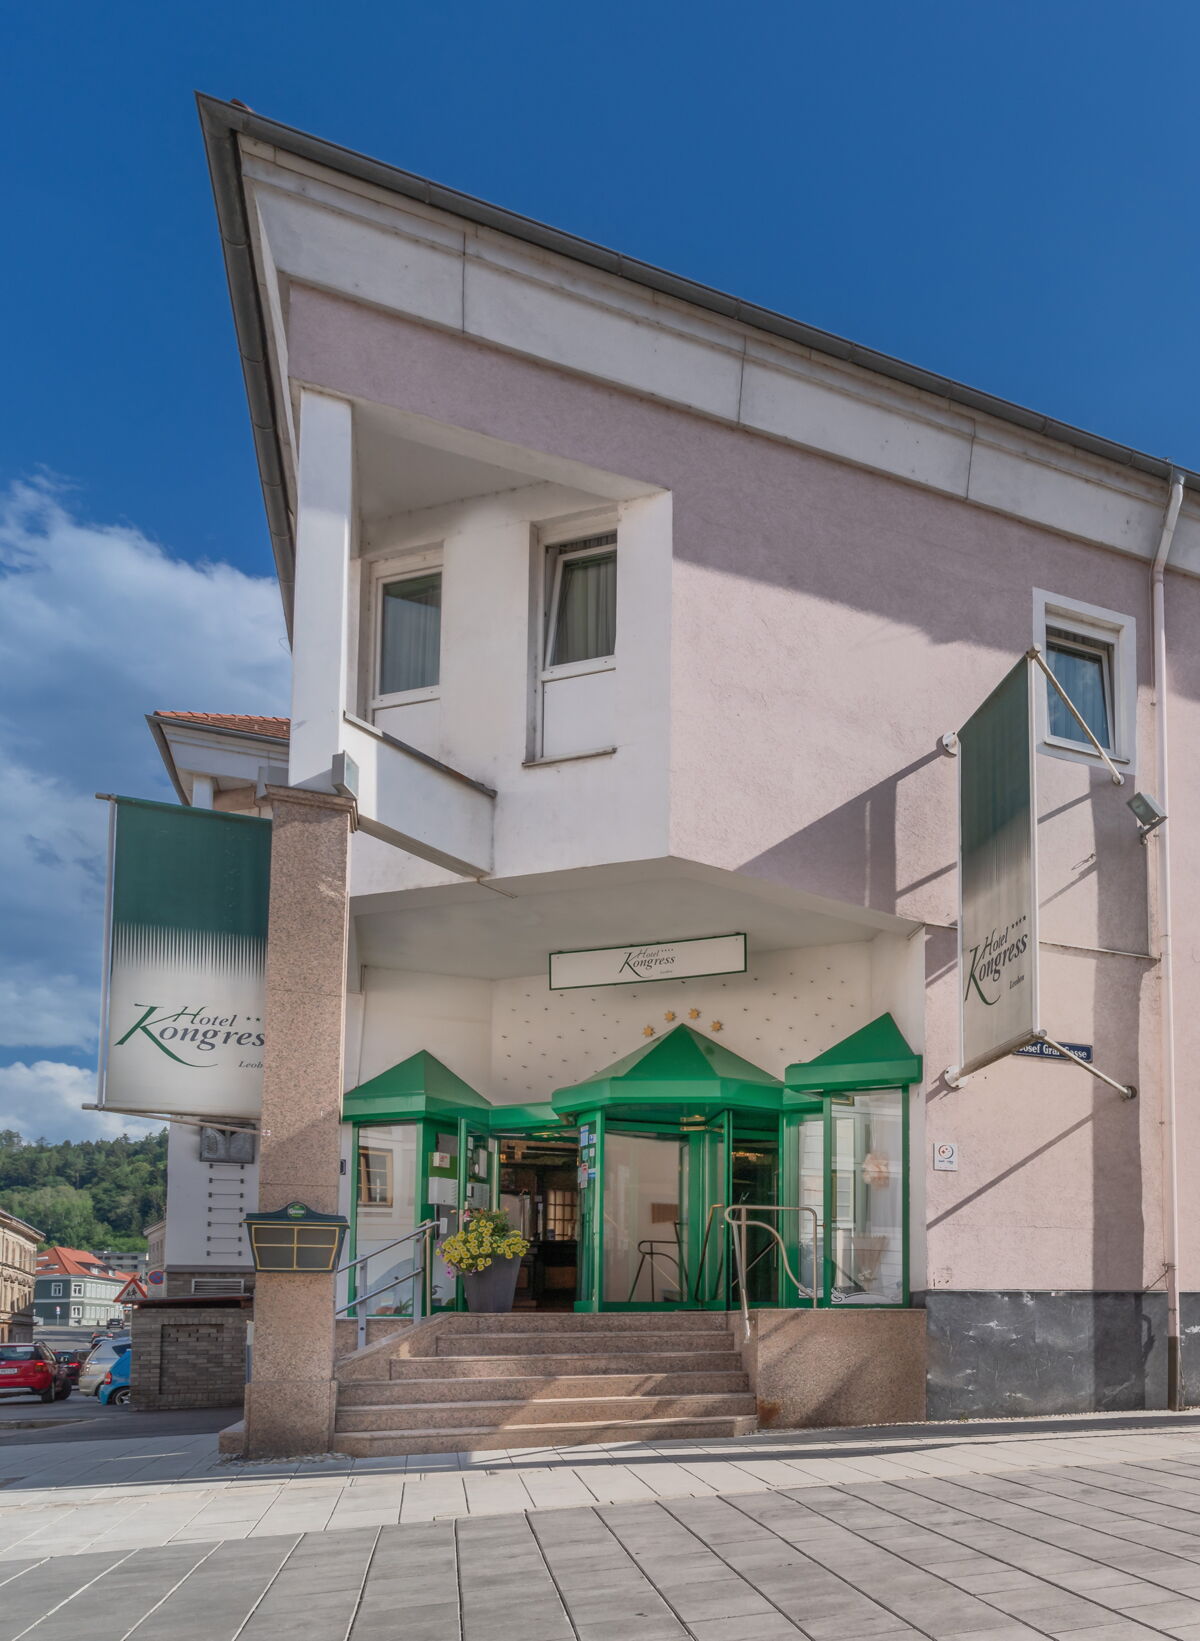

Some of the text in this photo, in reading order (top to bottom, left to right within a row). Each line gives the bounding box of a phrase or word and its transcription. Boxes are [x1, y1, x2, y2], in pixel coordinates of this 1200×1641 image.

[636, 948, 661, 959] Hotel
[983, 926, 1009, 957] Hotel
[619, 952, 676, 978] Kongress
[964, 933, 1028, 1006] Kongress
[172, 1005, 238, 1027] Hotel
[1065, 1046, 1087, 1059] asse
